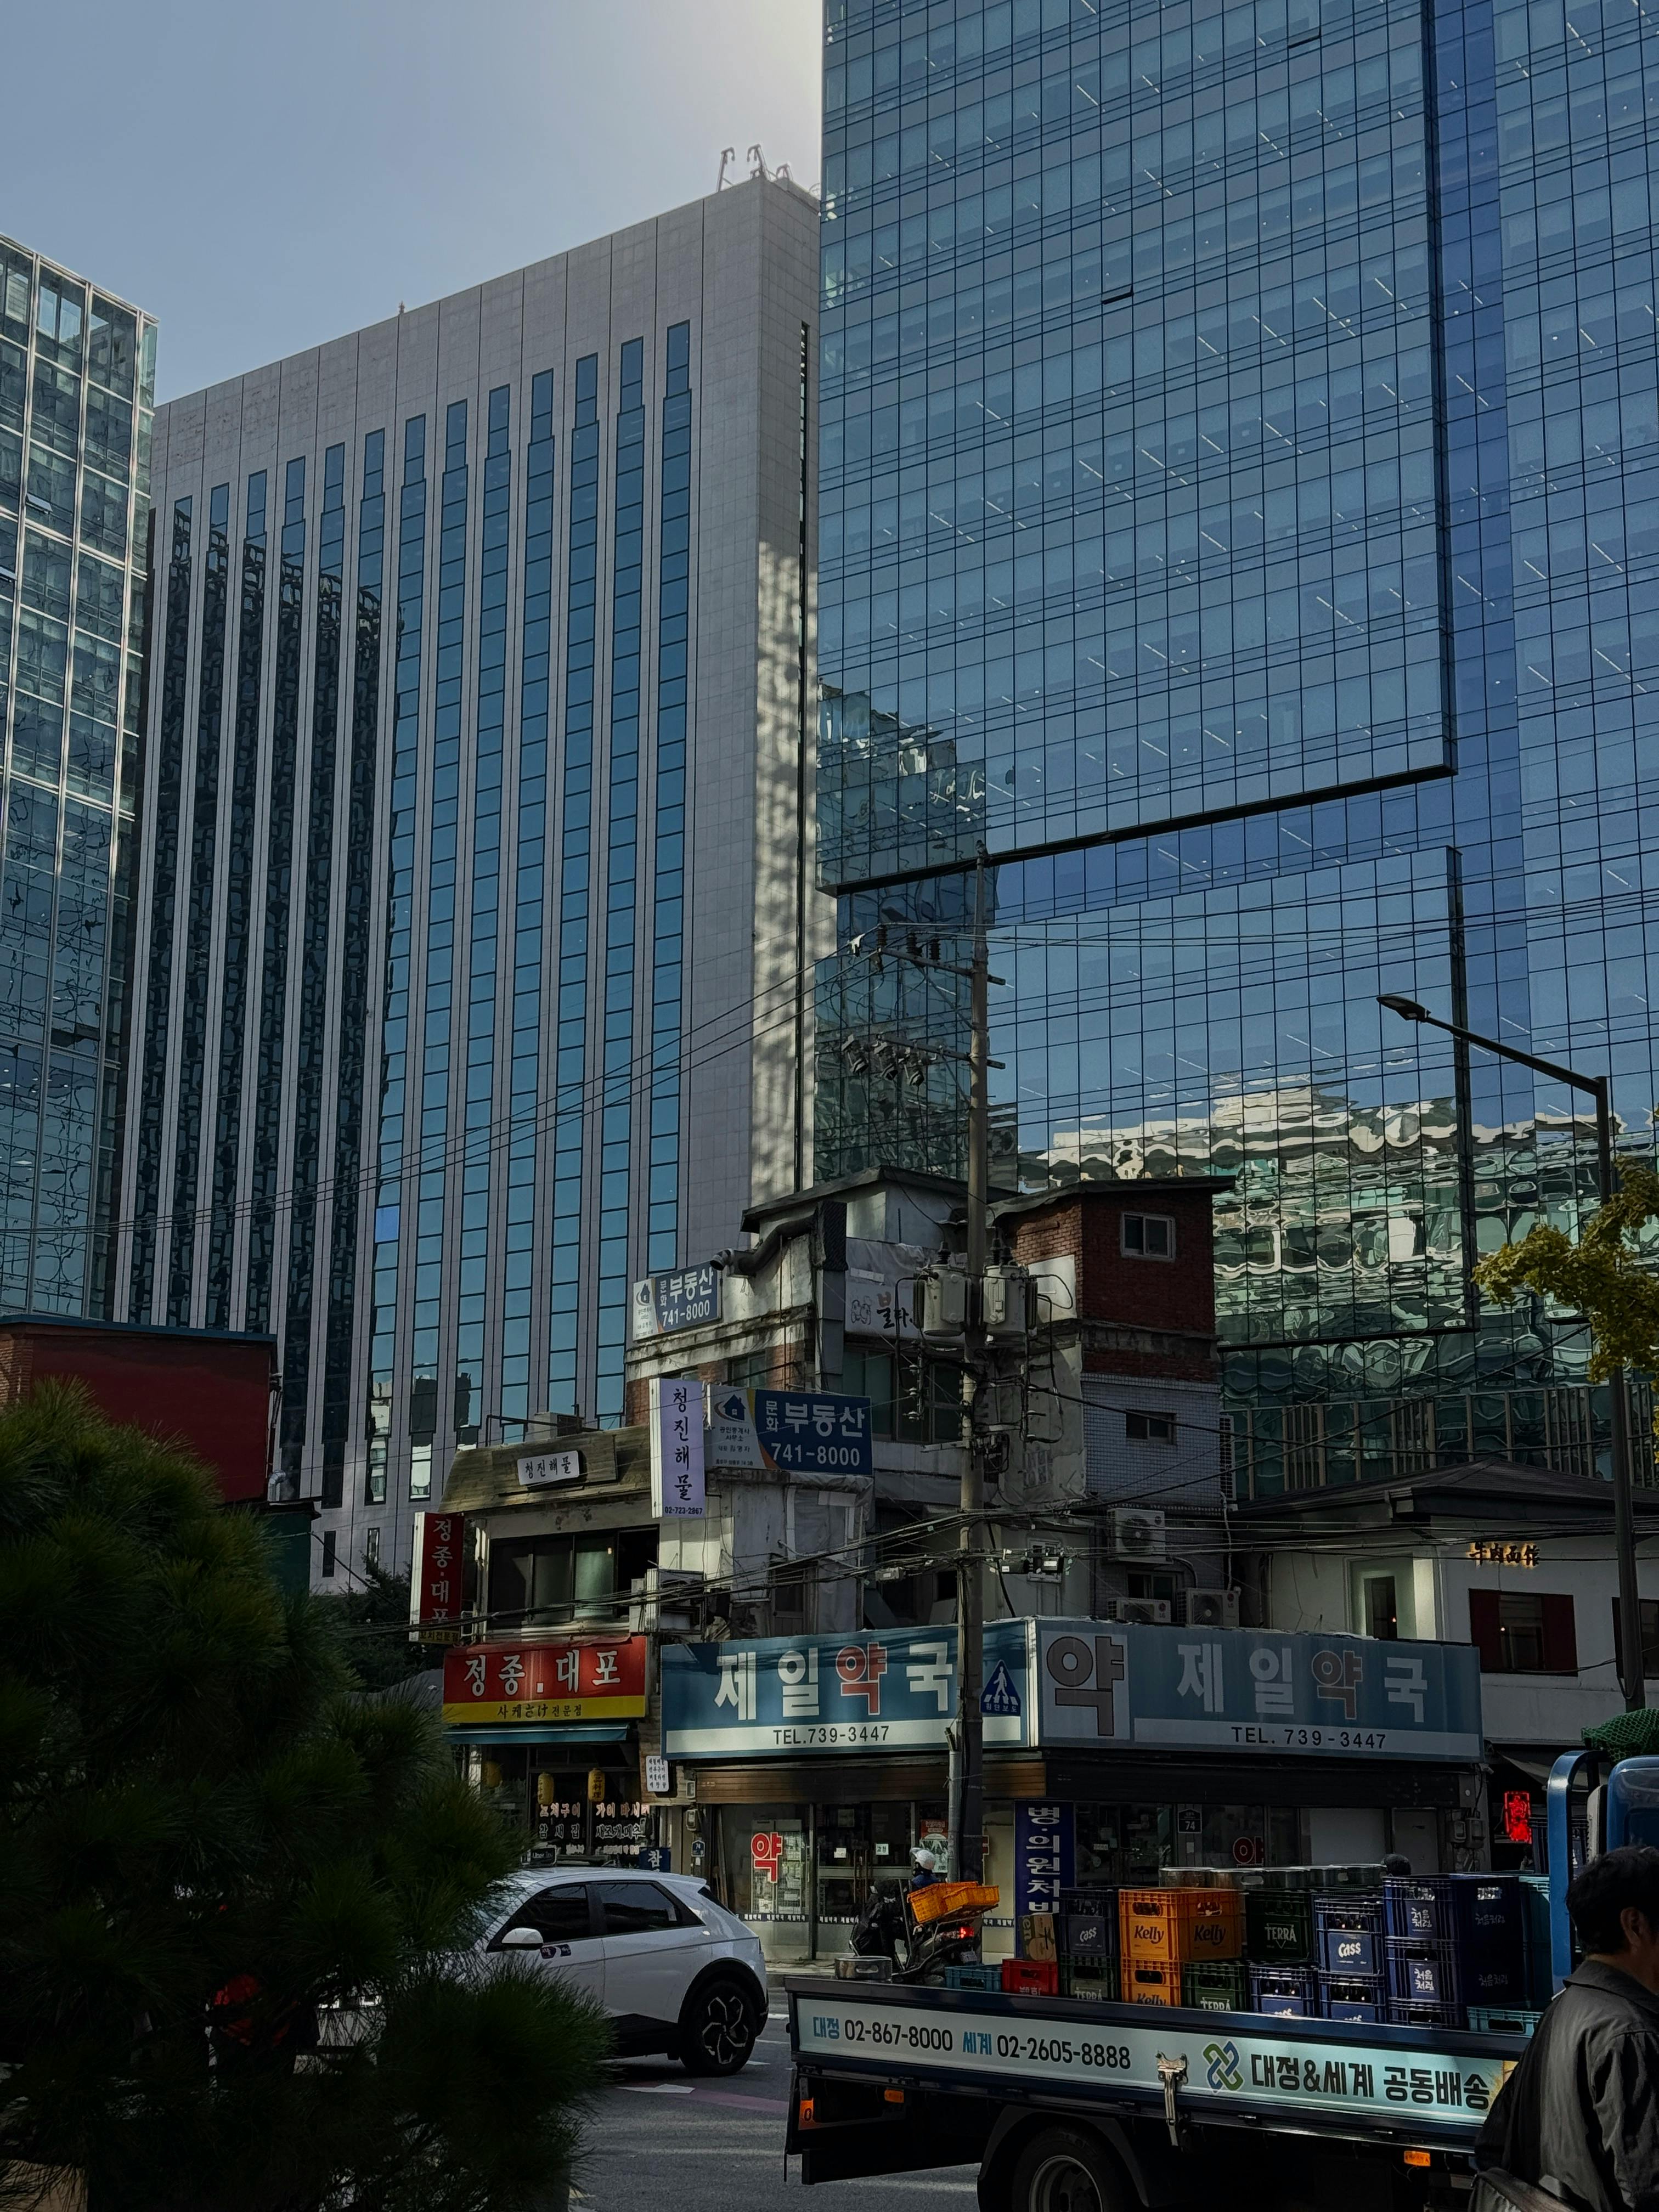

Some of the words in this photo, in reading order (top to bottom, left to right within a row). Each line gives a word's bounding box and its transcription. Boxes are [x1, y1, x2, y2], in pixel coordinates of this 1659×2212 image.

[669, 1266, 714, 1304] 부동산
[662, 1299, 710, 1327] 741-8000
[766, 1400, 779, 1432] 문화
[785, 1402, 865, 1437] 부동산
[720, 1426, 751, 1435] 공인중개사
[673, 1387, 692, 1500] 청진해물
[771, 1442, 860, 1466] 741-8000
[525, 1455, 572, 1480] 청진해물
[462, 1649, 621, 1697] 정종.대포
[714, 1641, 953, 1722] 제일약국
[1177, 1642, 1429, 1724] 제일약국
[1046, 1635, 1125, 1736] 약
[773, 1725, 889, 1746] TEL.739-3447
[1284, 1728, 1387, 1750] 739-3447
[1184, 1820, 1196, 1831] 74
[647, 1849, 663, 1870] 참
[751, 1831, 783, 1883] 약
[1411, 1906, 1431, 1918] 처음
[1413, 1917, 1433, 1928] 처럼
[1475, 1913, 1506, 1927] 처음처럼
[1133, 1925, 1165, 1945] Kelly
[1194, 1924, 1227, 1946] Kelly
[1264, 1925, 1297, 1943] TERRA
[1414, 1969, 1433, 1980] 처음
[1415, 1979, 1434, 1992] 처럼
[1479, 1971, 1510, 1989] 처음처럼
[812, 2016, 840, 2040] 대정
[844, 2018, 953, 2052] 02-867-8000
[963, 2030, 992, 2056] 세계
[997, 2034, 1131, 2070] 02-2605-8888
[1251, 2053, 1374, 2098] 대정&세계
[1383, 2066, 1491, 2111] 공동배송
